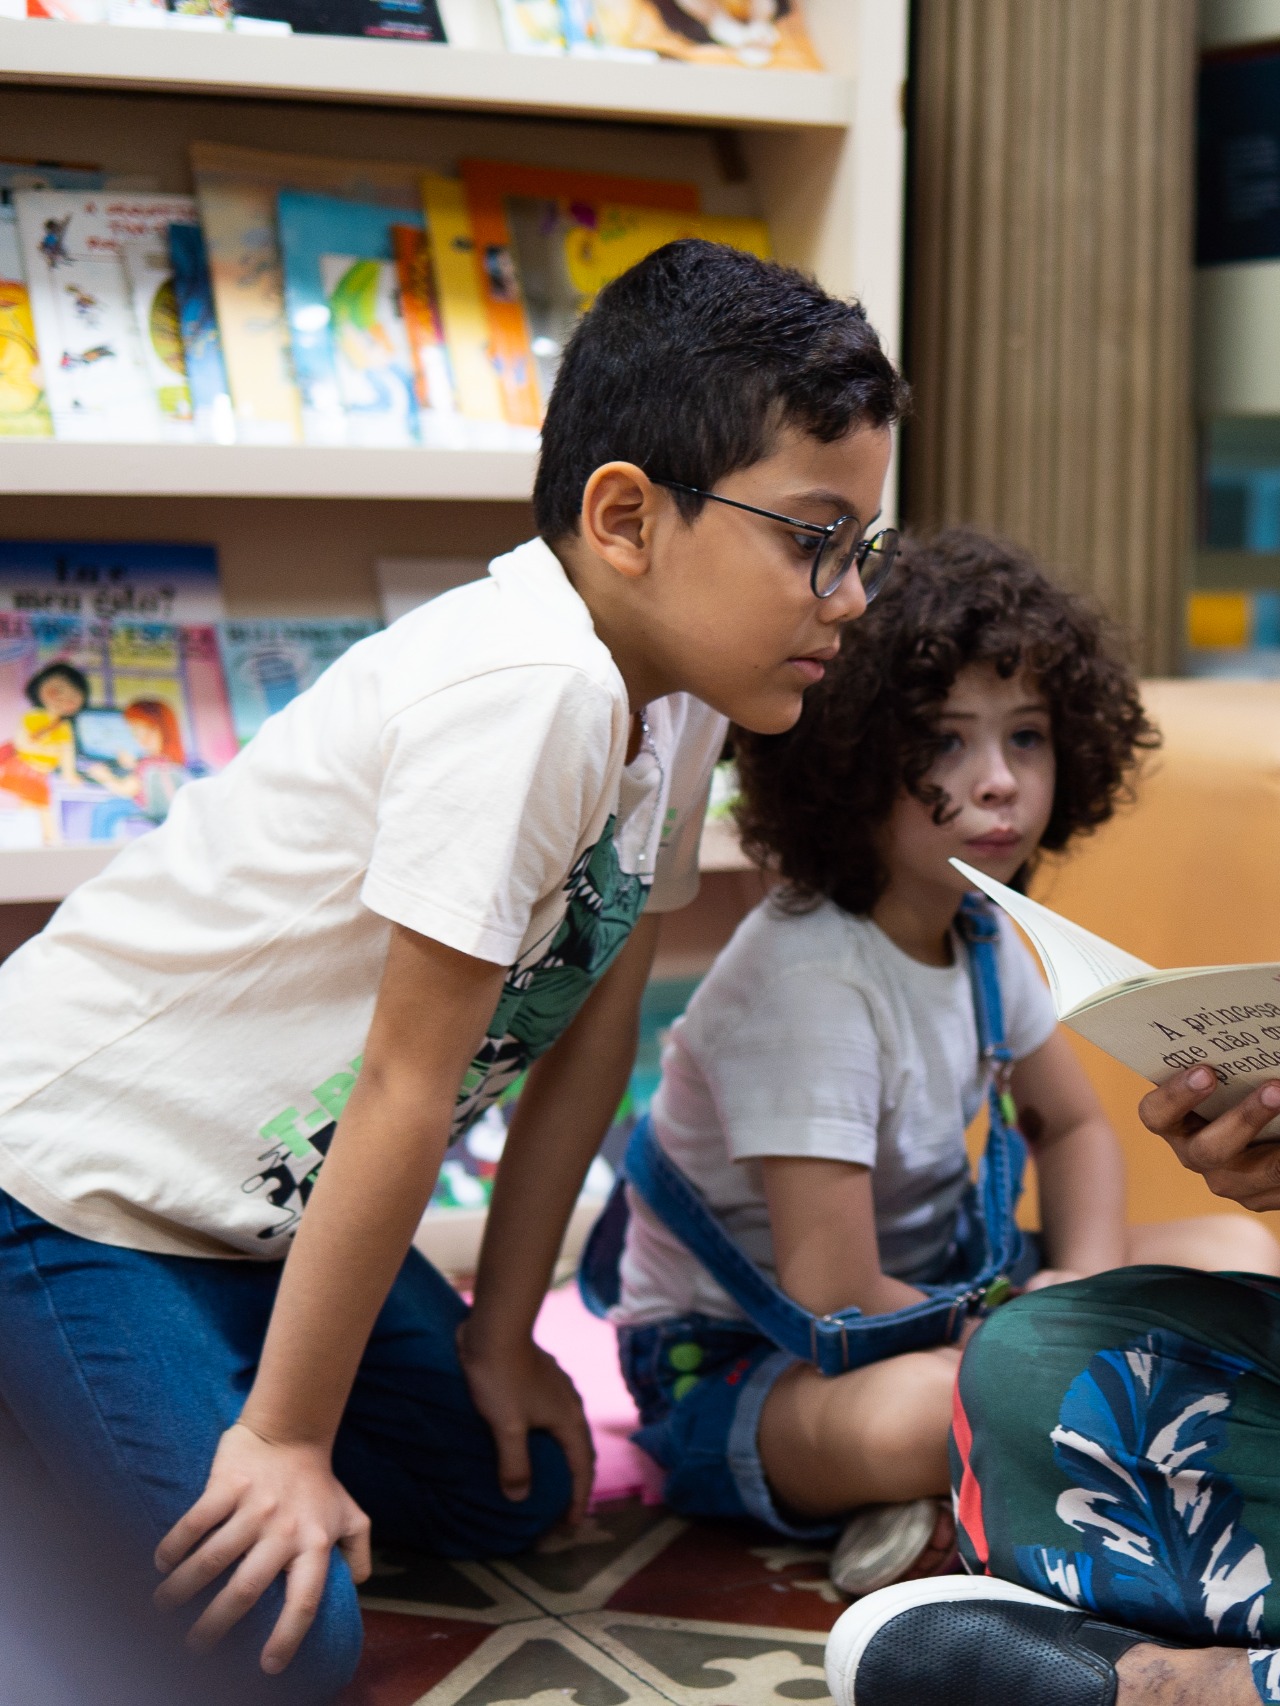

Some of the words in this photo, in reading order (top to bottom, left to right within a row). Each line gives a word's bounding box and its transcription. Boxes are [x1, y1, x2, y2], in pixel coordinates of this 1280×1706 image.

[1148, 1019, 1185, 1041] A
[1160, 1044, 1208, 1070] que
[1208, 1029, 1260, 1052] não
